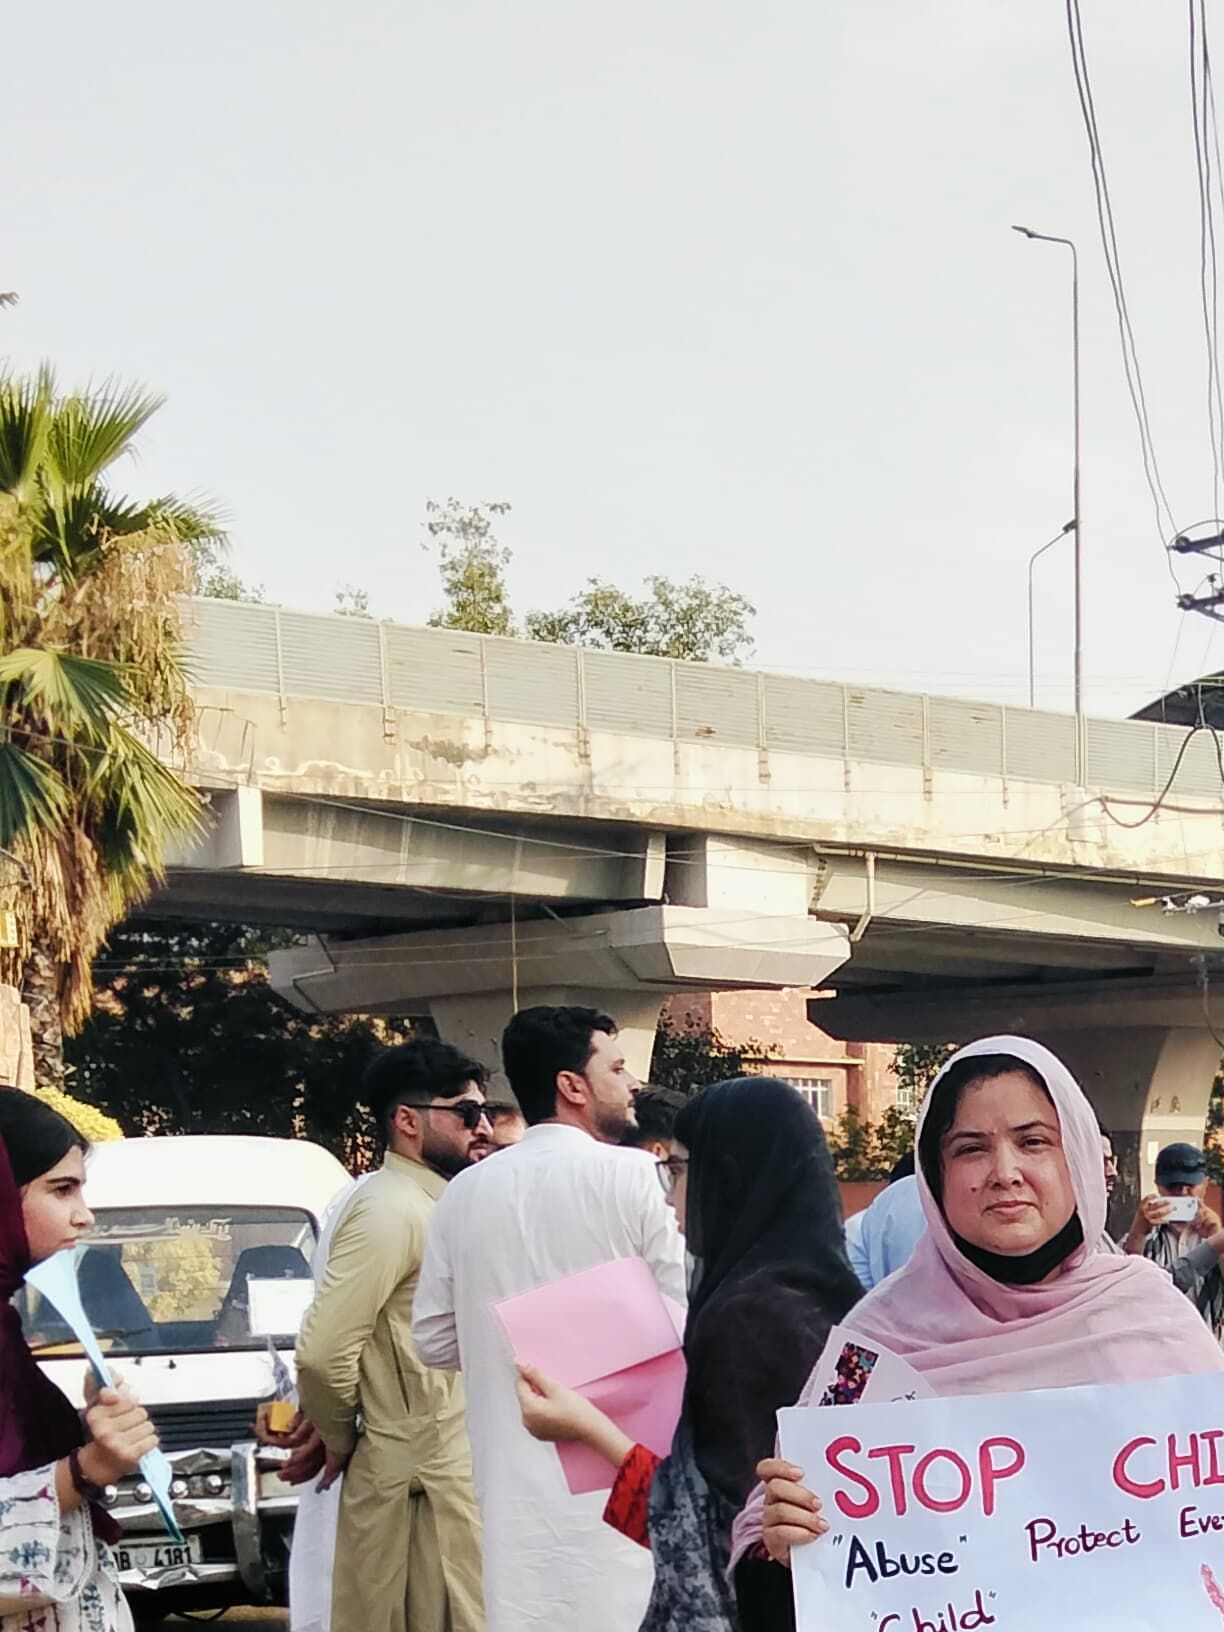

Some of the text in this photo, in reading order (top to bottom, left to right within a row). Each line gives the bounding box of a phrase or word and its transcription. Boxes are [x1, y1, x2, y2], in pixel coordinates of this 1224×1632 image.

[825, 1435, 1027, 1519] STOP
[154, 1545, 193, 1567] 4181
[1024, 1517, 1141, 1562] Protect
